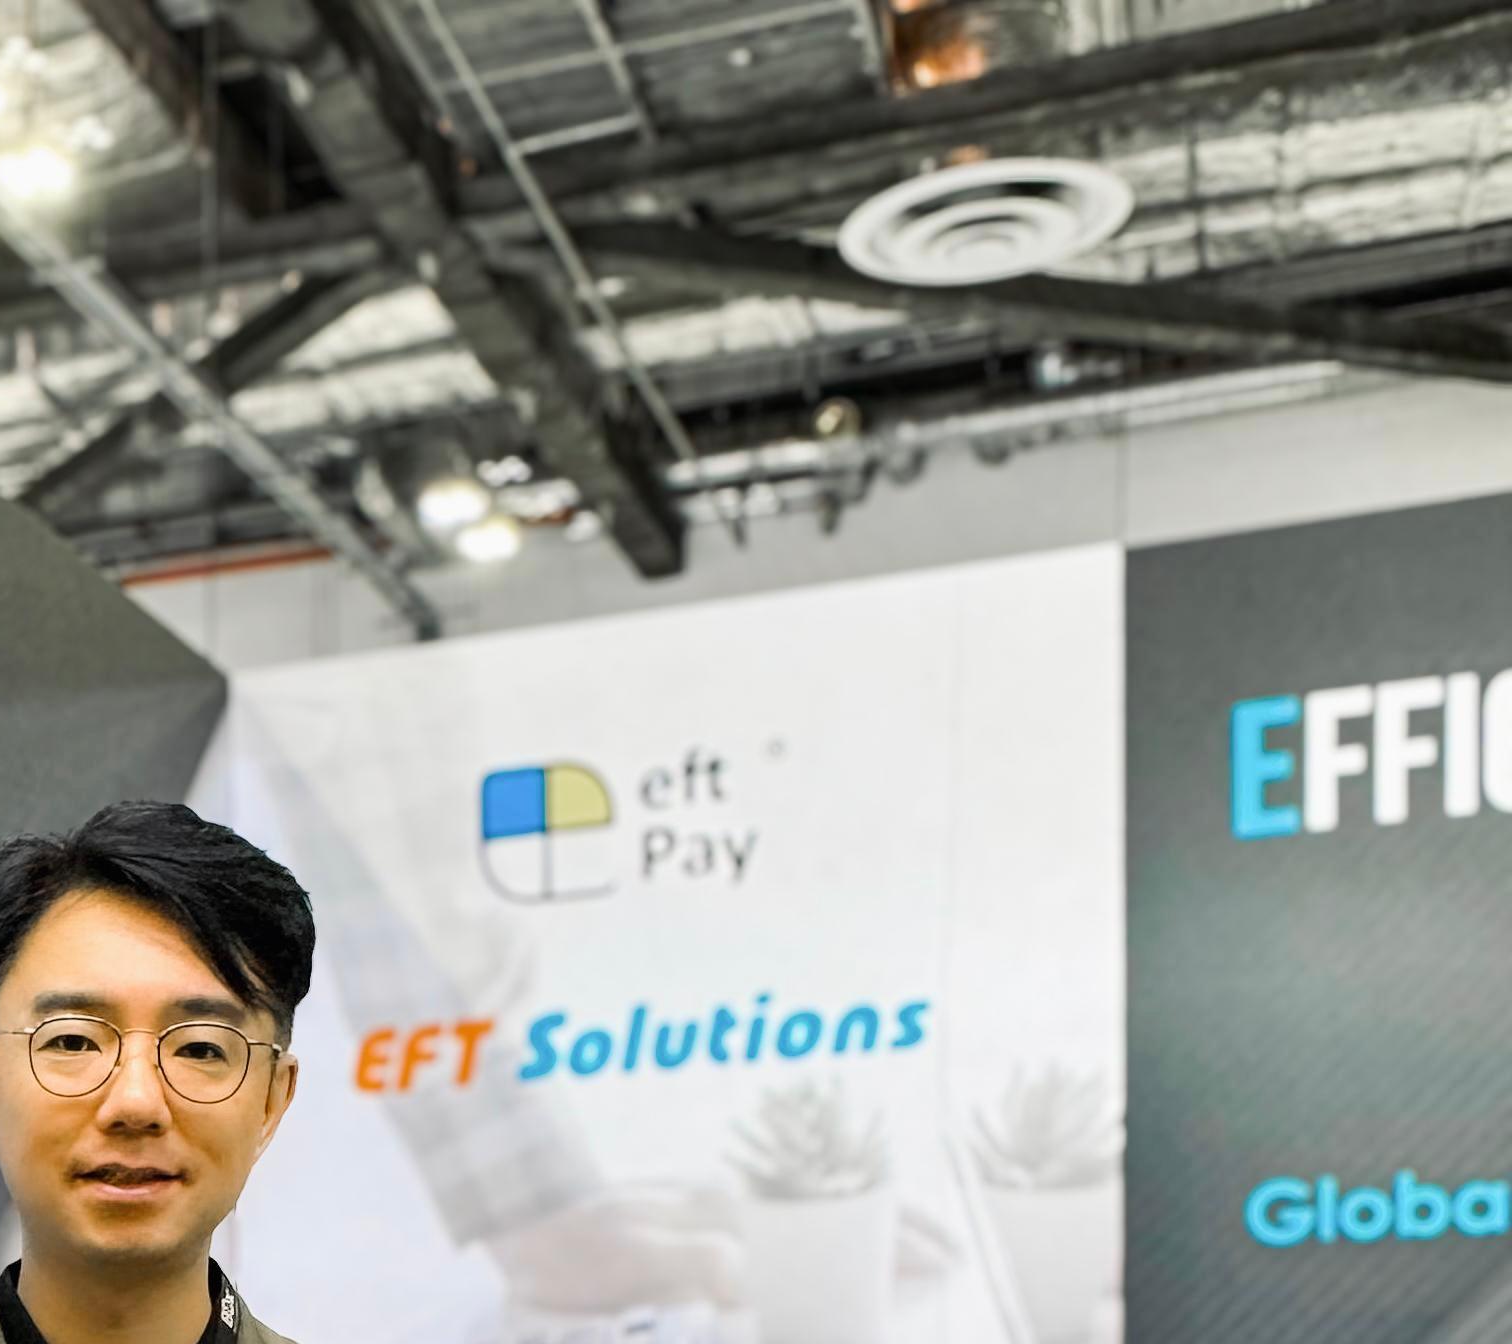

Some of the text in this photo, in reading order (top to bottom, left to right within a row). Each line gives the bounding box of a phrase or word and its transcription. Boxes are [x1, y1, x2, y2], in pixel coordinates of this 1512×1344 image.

[640, 748, 730, 809] eft
[641, 827, 757, 886] Pay
[353, 993, 931, 1093] EFT Solutions
